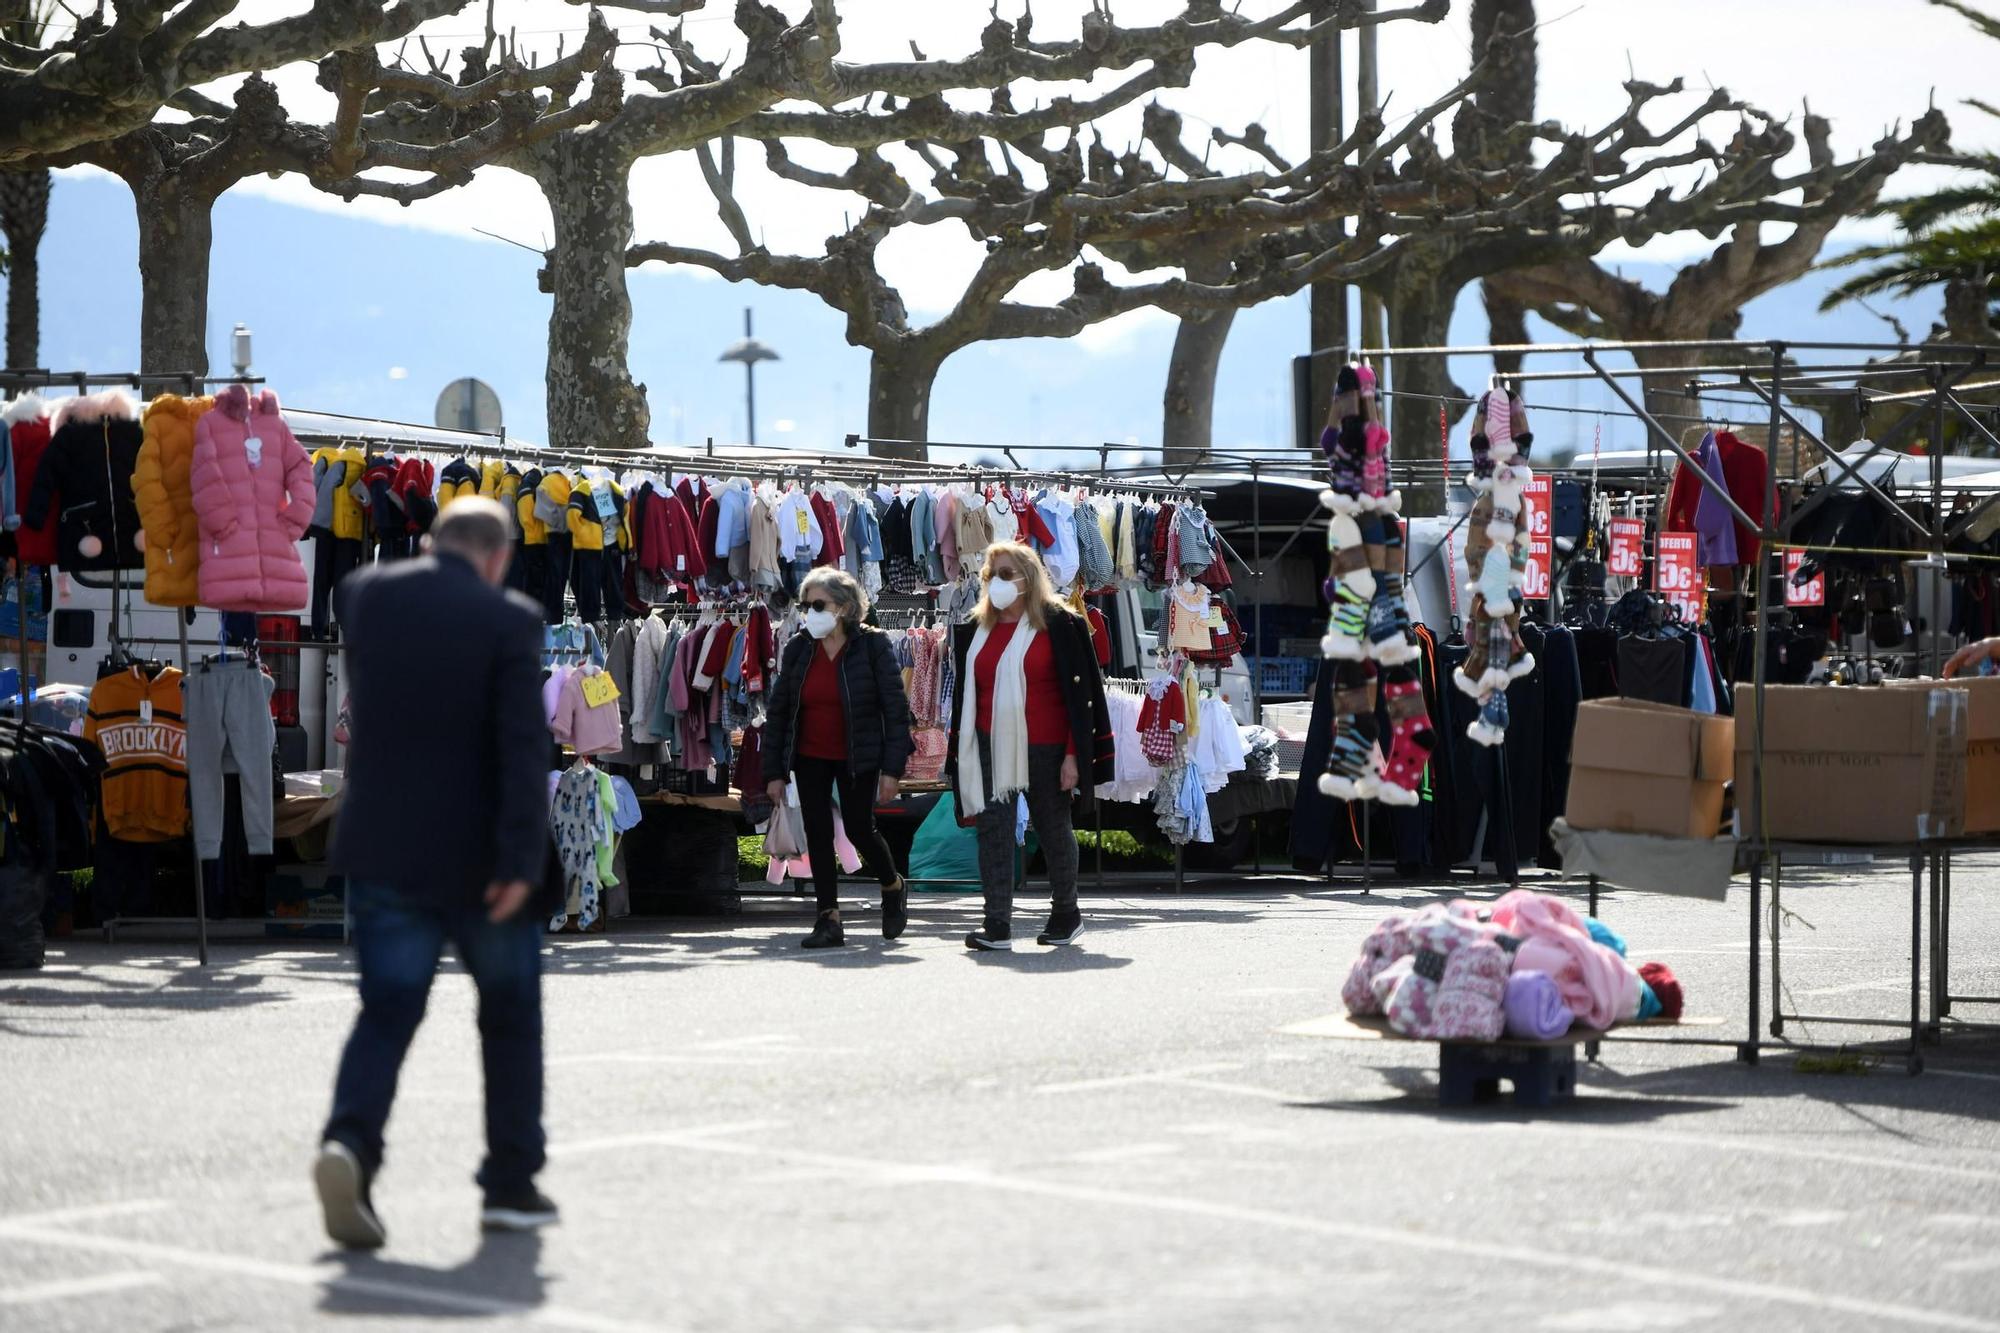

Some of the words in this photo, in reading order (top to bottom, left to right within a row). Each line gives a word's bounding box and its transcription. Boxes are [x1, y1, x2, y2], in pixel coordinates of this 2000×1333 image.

[1520, 480, 1548, 493] FERTA
[1613, 522, 1640, 536] OFERTA
[1658, 537, 1692, 549] OFERTA
[1658, 553, 1692, 589] 5€
